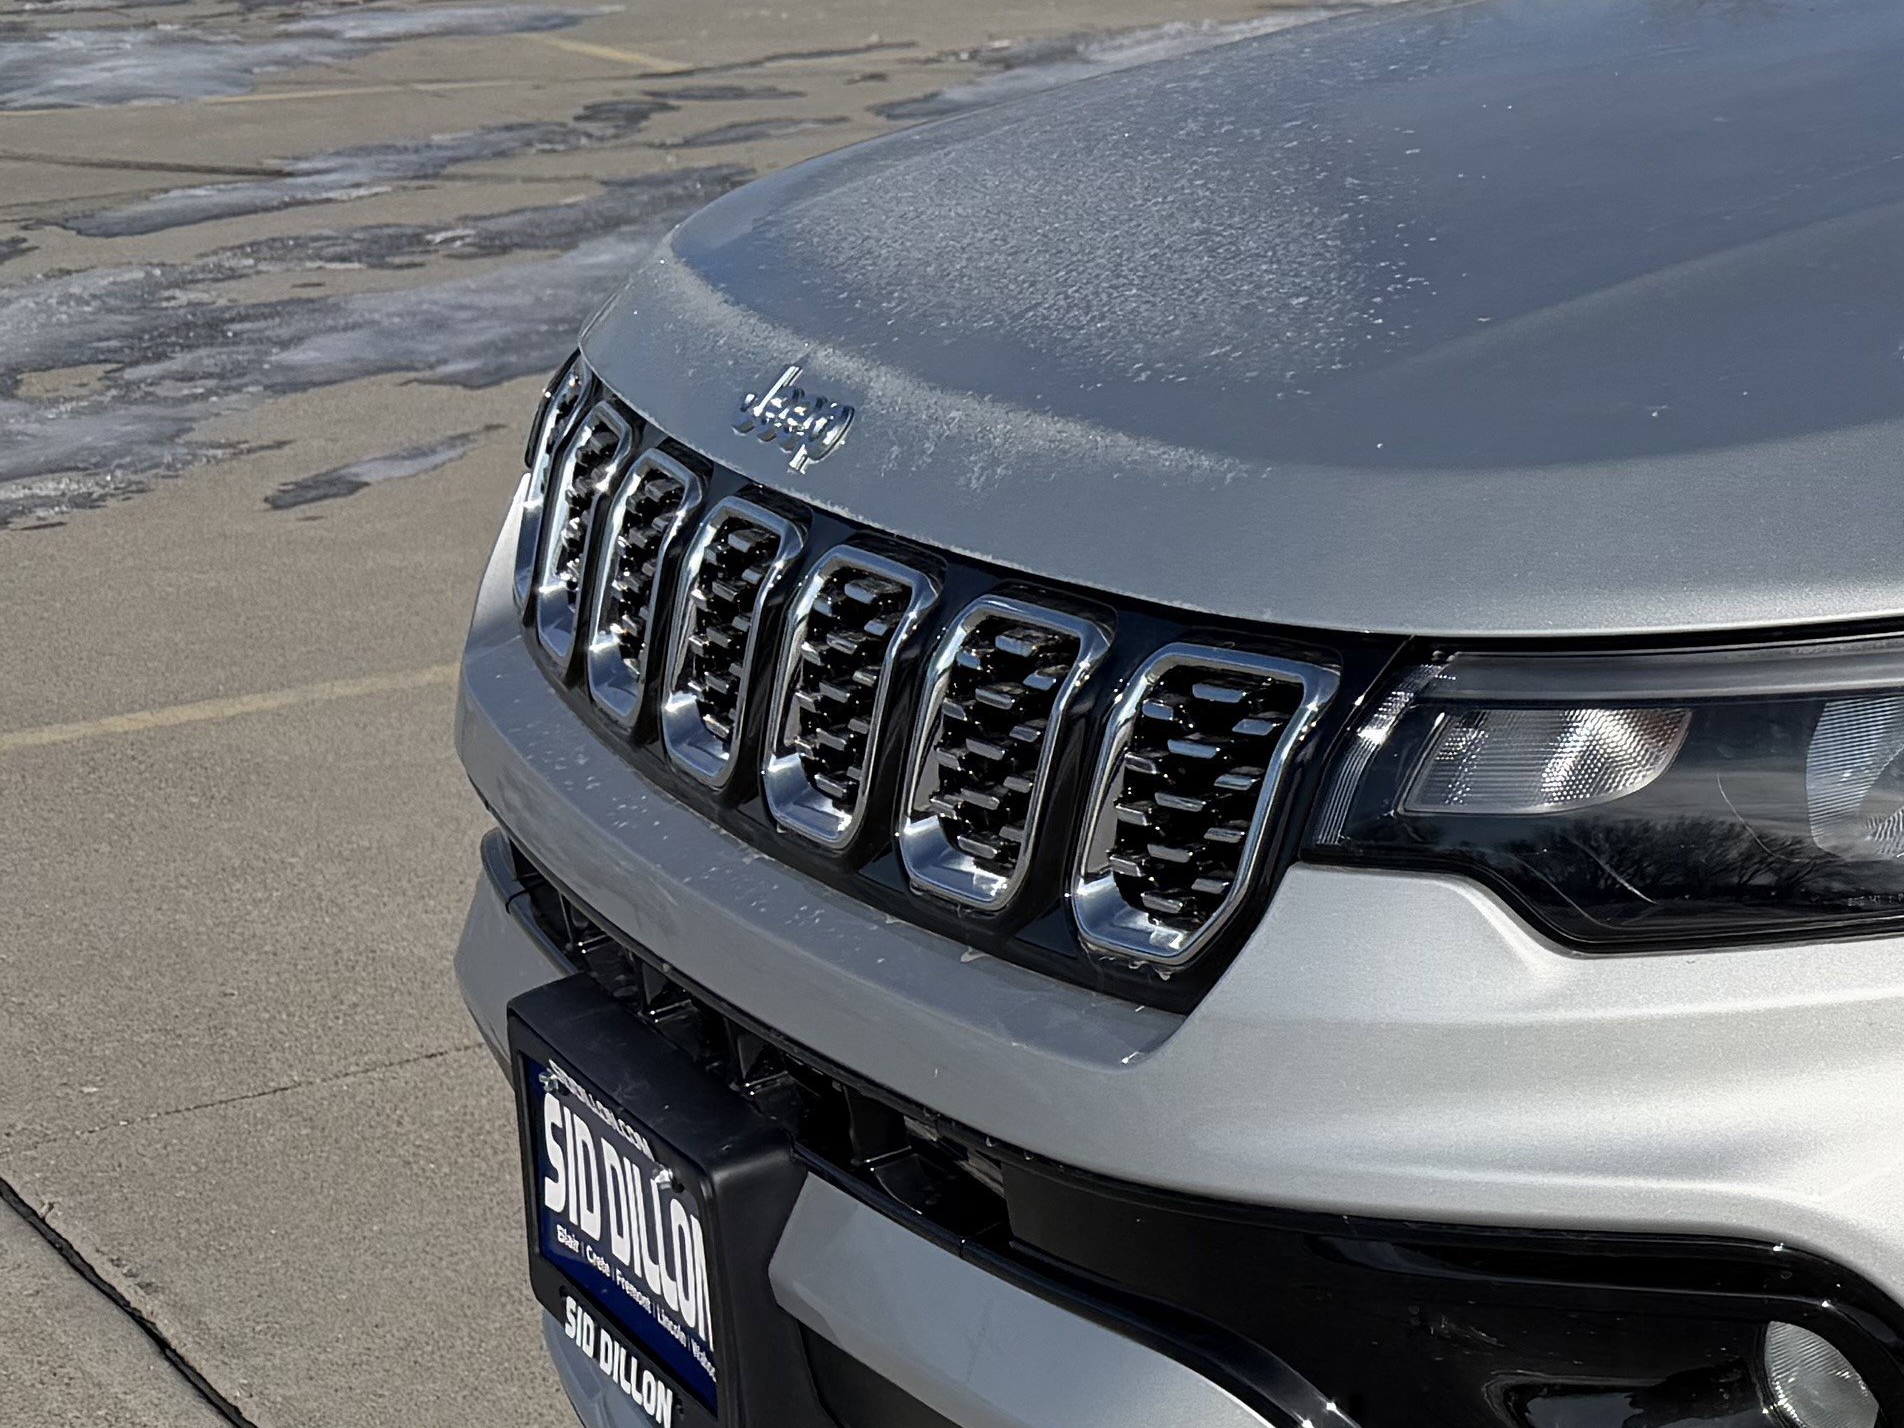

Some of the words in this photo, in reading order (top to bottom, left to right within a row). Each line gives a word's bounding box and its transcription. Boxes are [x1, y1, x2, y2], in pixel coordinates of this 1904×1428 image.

[731, 366, 856, 474] Jeep
[544, 1092, 602, 1242] SID
[601, 1136, 715, 1352] DILLON
[556, 1224, 579, 1254] Blair
[565, 1295, 595, 1360] SID
